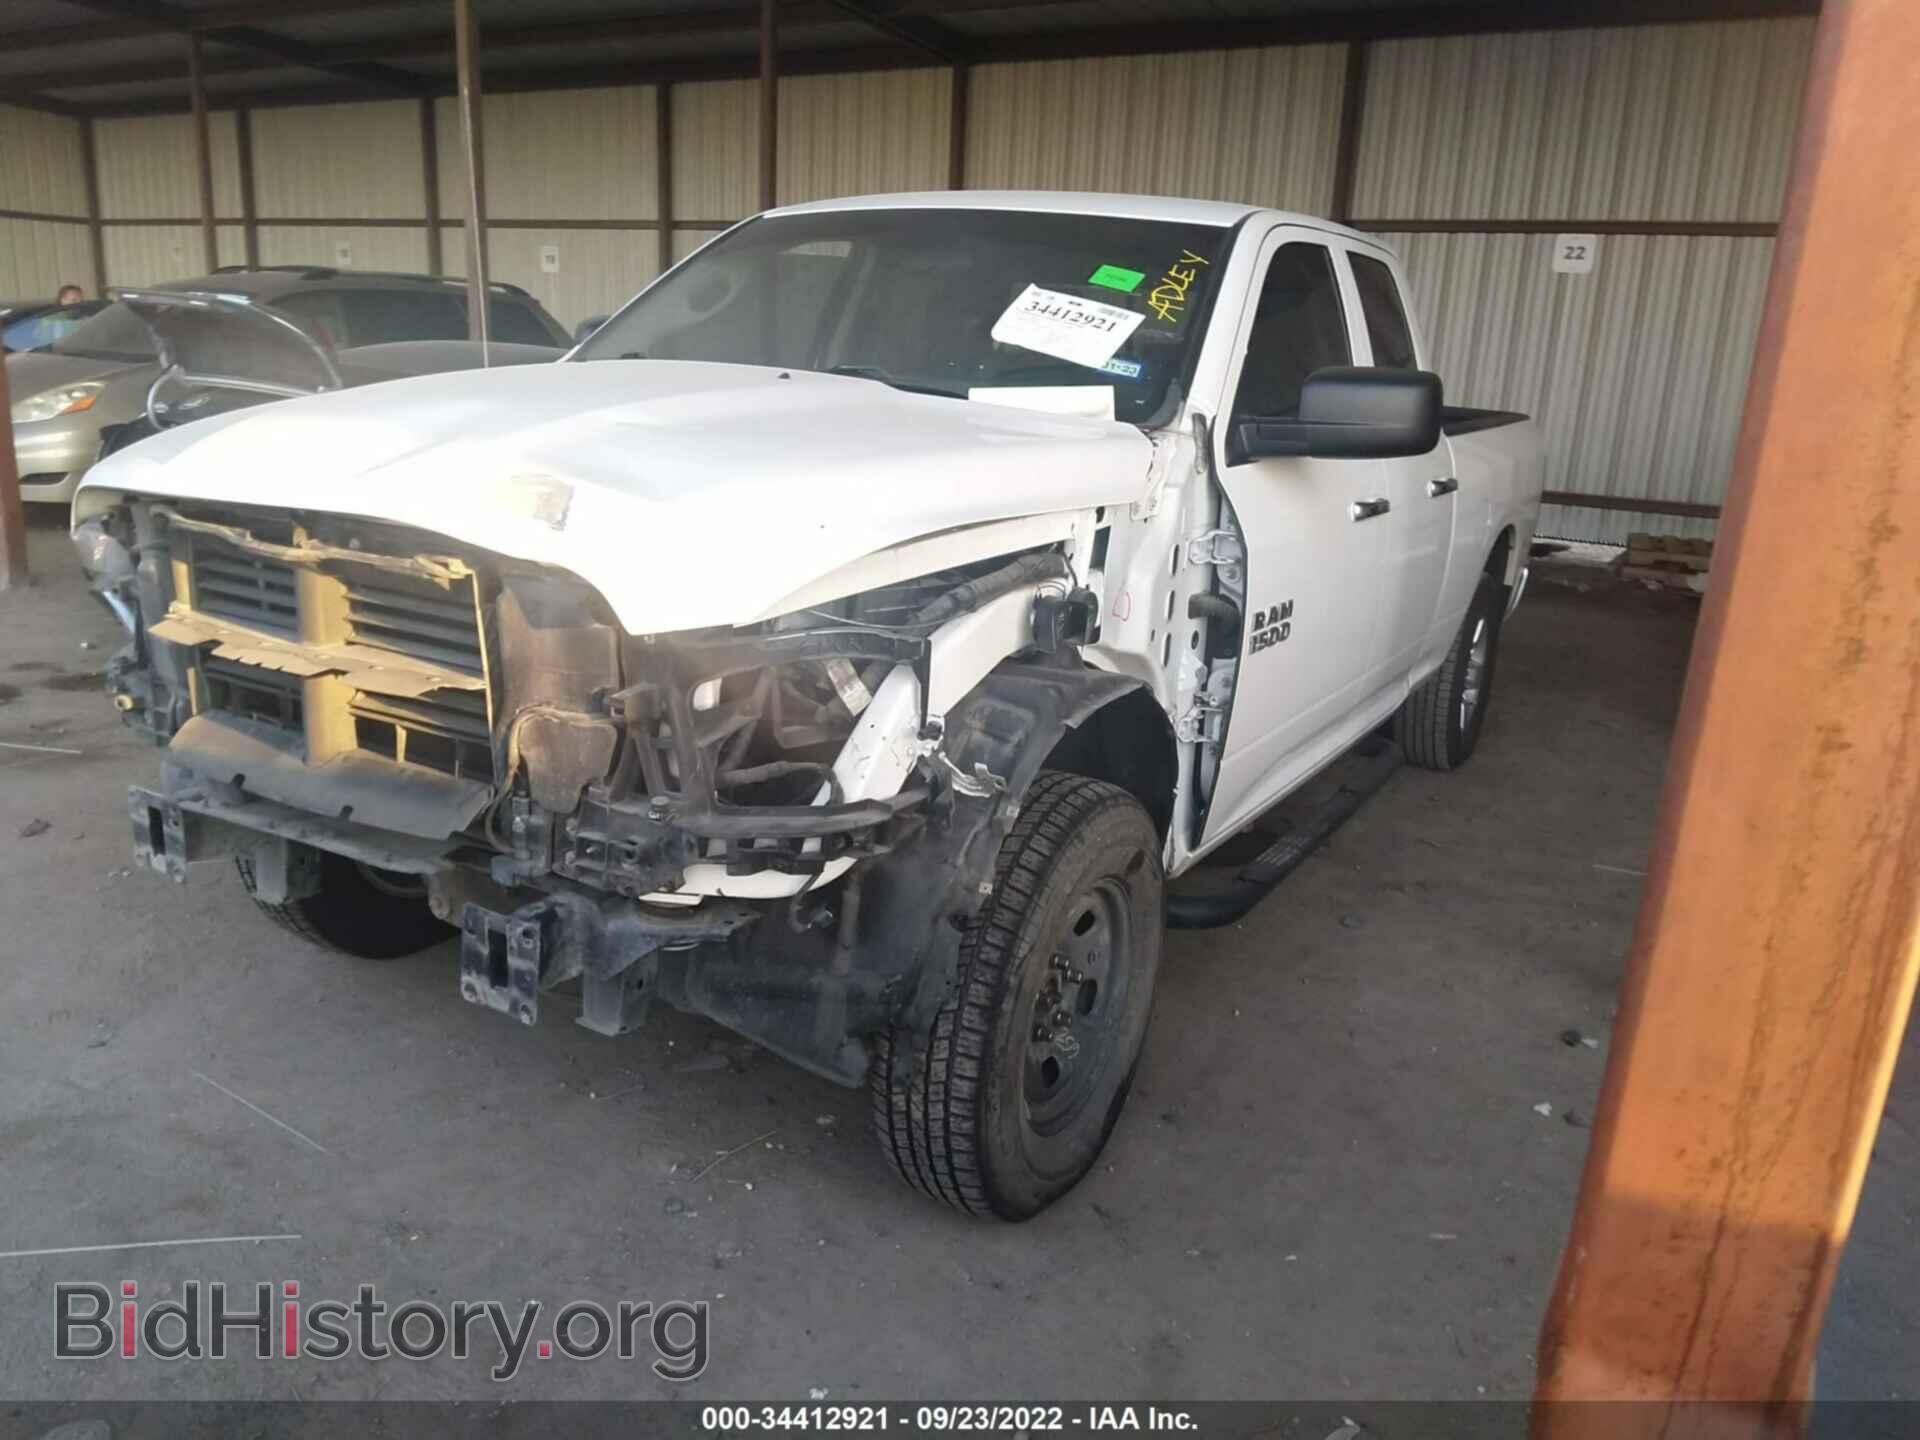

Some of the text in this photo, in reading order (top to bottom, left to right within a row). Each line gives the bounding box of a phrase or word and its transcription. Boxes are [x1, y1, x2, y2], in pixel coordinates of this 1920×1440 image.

[1563, 245, 1587, 260] 22
[1024, 300, 1117, 332] 34412921
[1251, 598, 1294, 632] RAM
[1248, 620, 1291, 655] 1500
